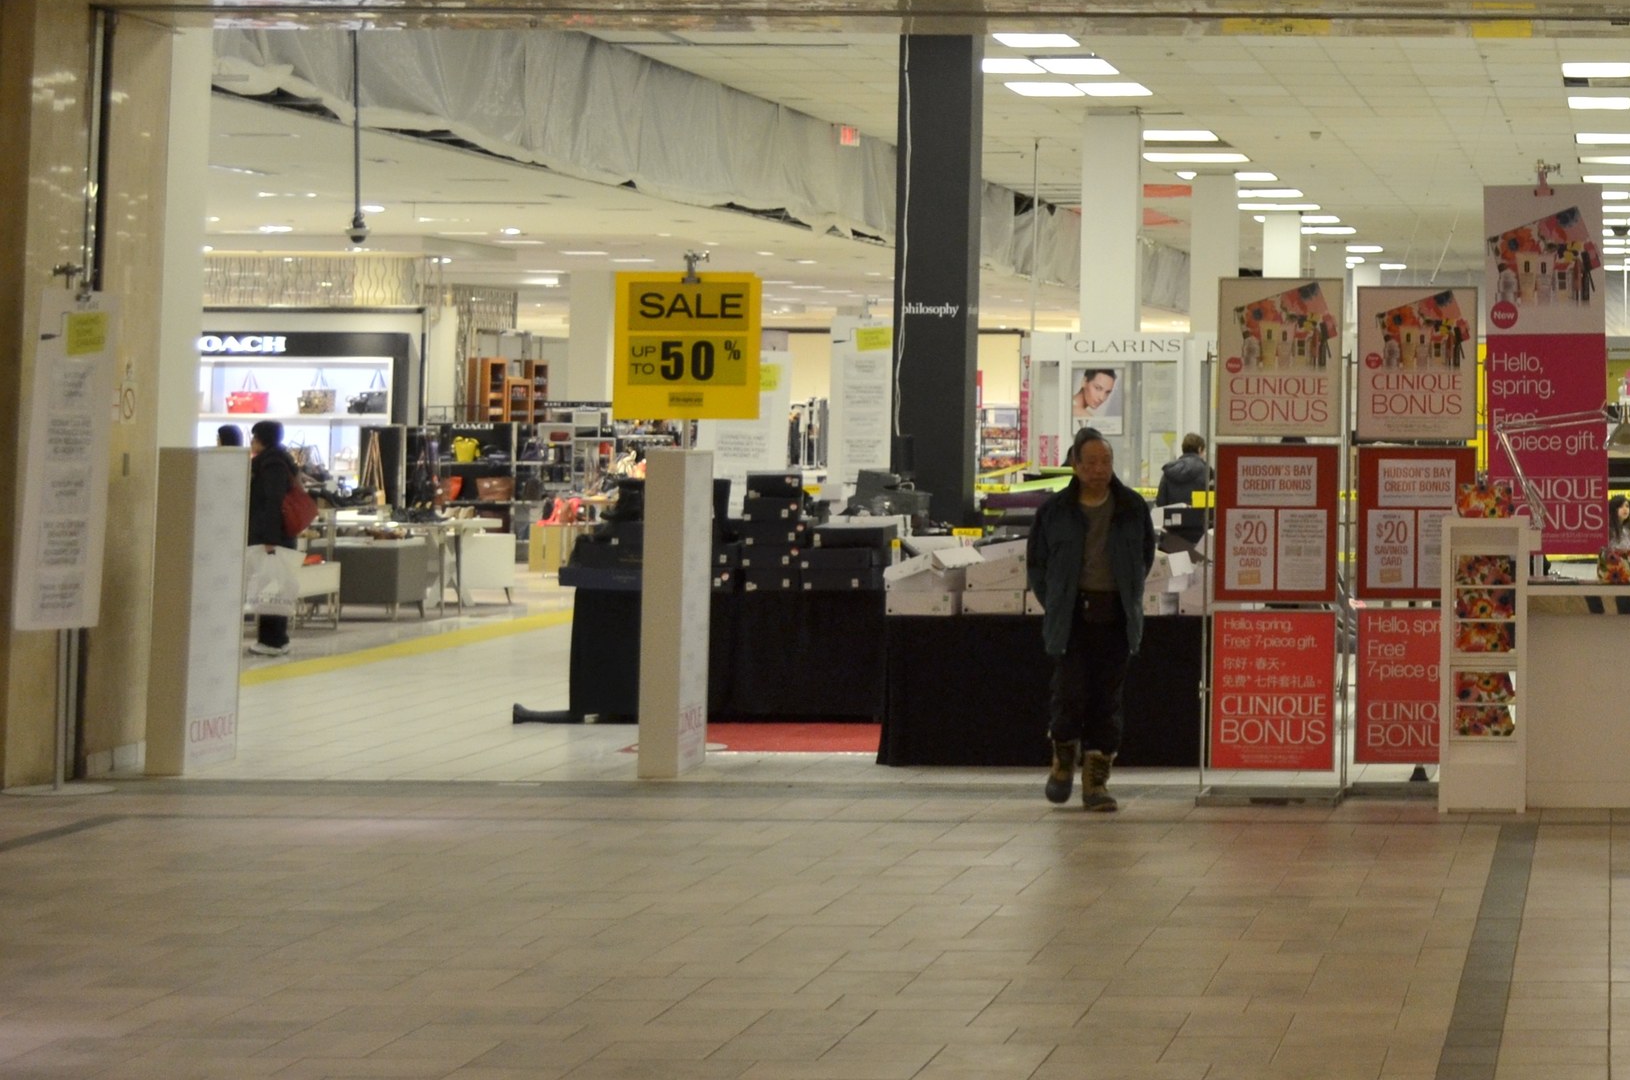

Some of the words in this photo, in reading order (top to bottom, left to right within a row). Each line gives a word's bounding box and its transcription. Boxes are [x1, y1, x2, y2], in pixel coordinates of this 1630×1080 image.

[639, 292, 744, 319] SALE
[901, 302, 960, 318] philosophy
[1494, 311, 1514, 320] New
[200, 335, 287, 352] OACH
[631, 345, 657, 358] UP
[1073, 338, 1181, 354] CLARINS
[631, 363, 656, 375] TO
[1491, 351, 1544, 374] Hello,
[1229, 377, 1329, 398] CLINIQUE
[1371, 373, 1462, 392] CLINIQUE
[1491, 377, 1556, 399] spring.
[1229, 399, 1329, 422] BONUS
[1371, 394, 1462, 415] BONUS
[1565, 431, 1599, 456] gift.
[1293, 464, 1314, 477] BAY
[1433, 467, 1452, 478] BAY
[1242, 478, 1277, 492] CREDIT
[1279, 478, 1312, 491] BONUS
[1384, 480, 1417, 492] CREDIT
[1419, 480, 1451, 492] BONUS
[1234, 520, 1267, 545] $20
[1376, 520, 1408, 544] $20
[1232, 546, 1268, 557] SAVINGS
[1374, 545, 1408, 556] SAVINGS
[1239, 558, 1262, 568] CARD
[1380, 556, 1402, 567] CARD
[1223, 617, 1254, 632] Hello,
[1256, 618, 1293, 633] spring.
[1367, 616, 1410, 635] Hello,
[1254, 634, 1296, 651] 7-piece
[1297, 634, 1317, 650] gift.
[1367, 661, 1425, 680] 7-piece
[1220, 695, 1326, 718] CLINIQUE
[1367, 702, 1440, 723] CLINIQ
[1220, 719, 1326, 745] BONUS
[1367, 723, 1440, 747] BONU
